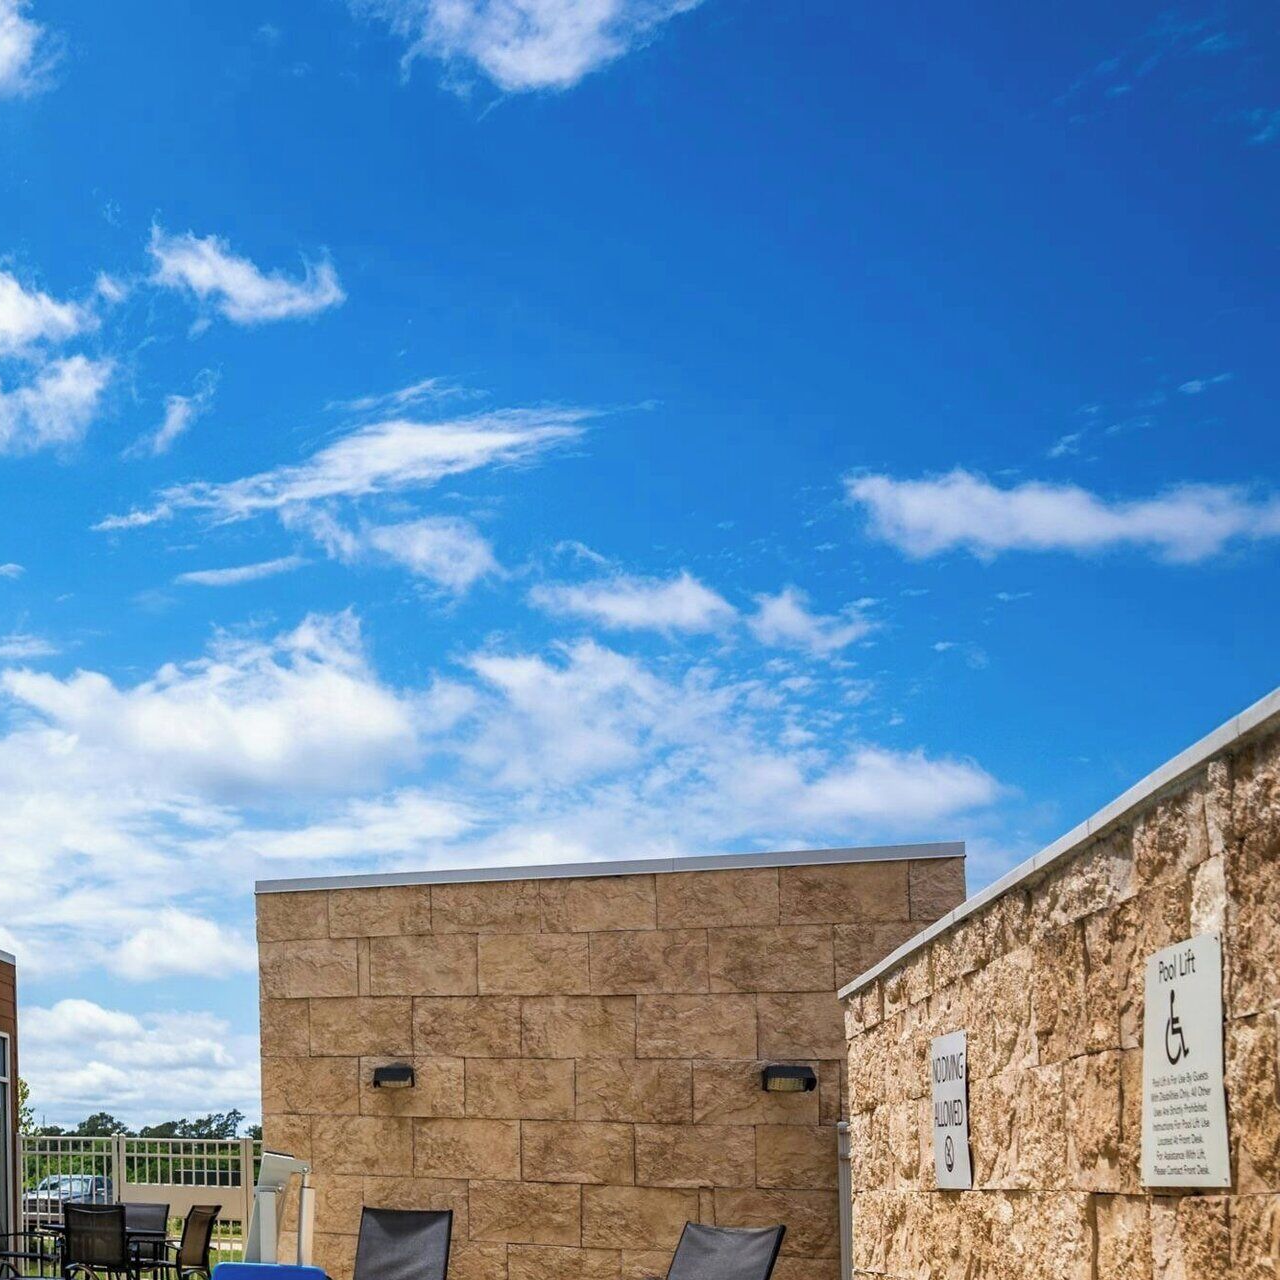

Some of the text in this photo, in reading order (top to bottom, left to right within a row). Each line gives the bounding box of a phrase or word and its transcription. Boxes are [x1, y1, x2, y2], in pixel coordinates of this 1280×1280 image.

[1158, 949, 1195, 983] Pool Lift
[934, 1099, 964, 1128] ALLOWED
